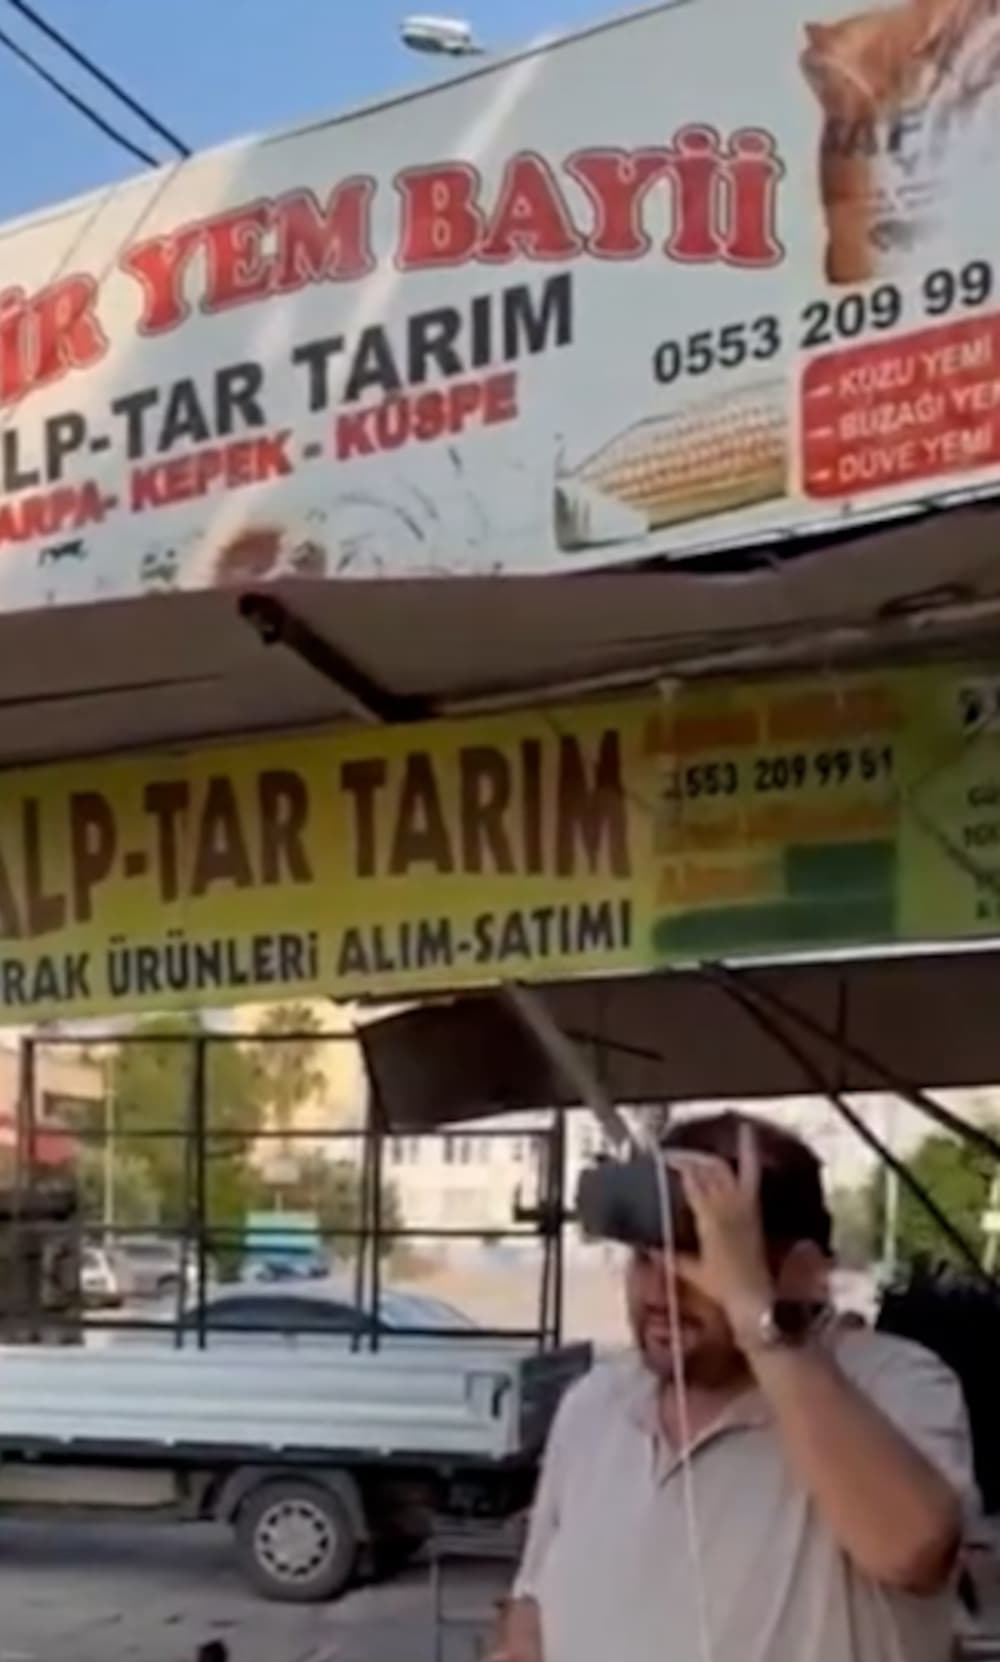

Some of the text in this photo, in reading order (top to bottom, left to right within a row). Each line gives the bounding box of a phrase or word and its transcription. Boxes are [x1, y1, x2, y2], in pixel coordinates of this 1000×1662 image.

[120, 175, 378, 337] YEM
[292, 271, 573, 412] TARIM
[653, 260, 992, 384] 0553 209 99
[838, 356, 915, 398] KUZU
[130, 431, 293, 511] KEPEK
[341, 730, 632, 880] TARIM
[754, 753, 807, 793] 209
[336, 899, 633, 977] ALIM-SATIMI
